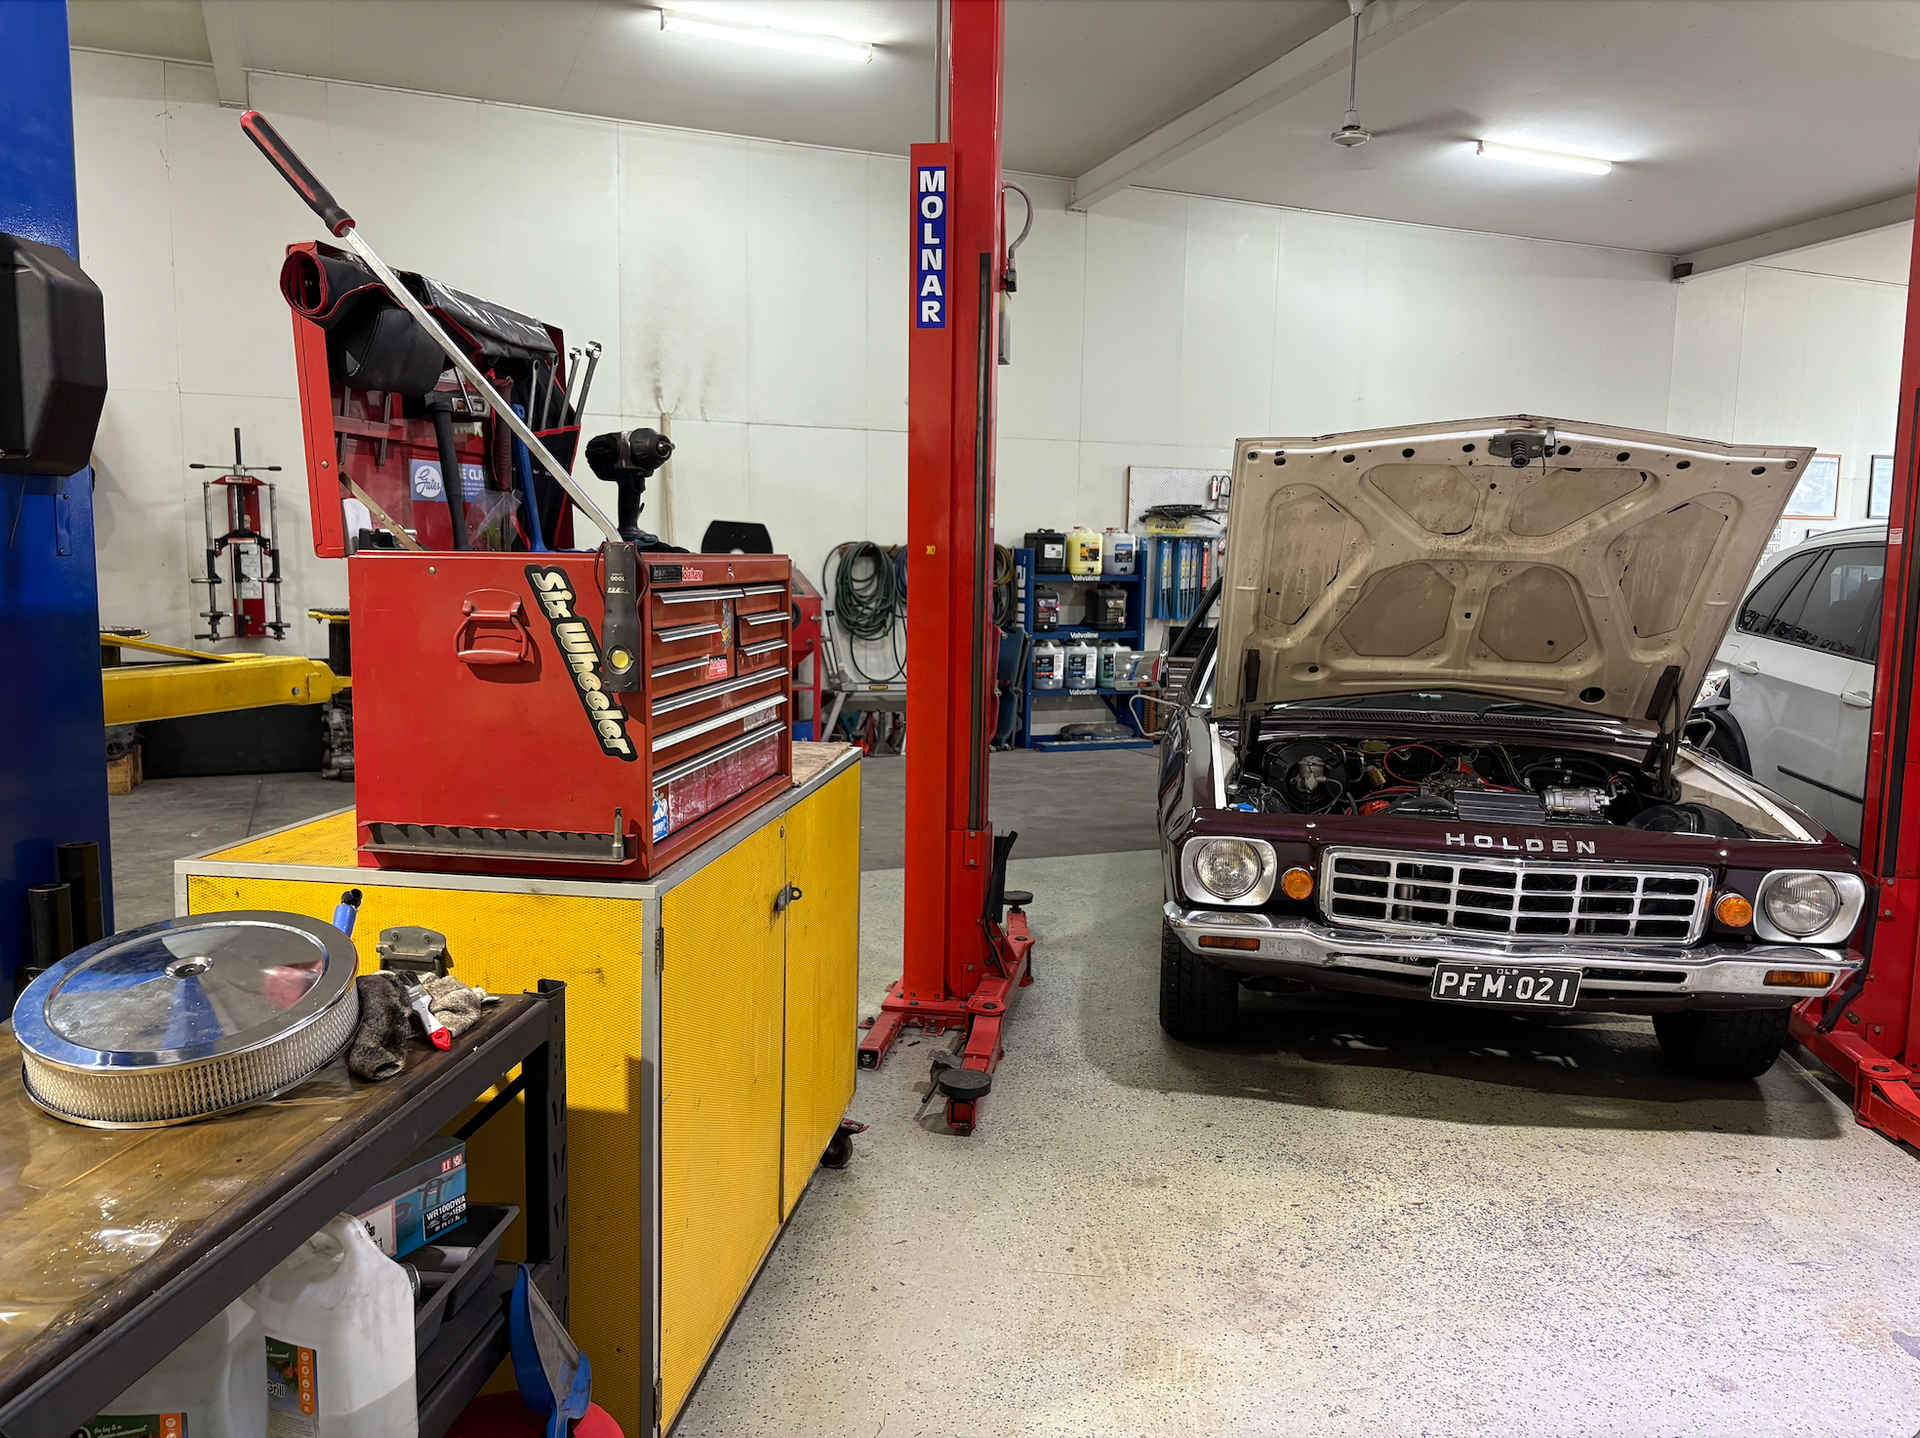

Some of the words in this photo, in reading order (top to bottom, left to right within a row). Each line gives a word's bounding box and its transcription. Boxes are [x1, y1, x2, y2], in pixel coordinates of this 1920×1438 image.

[919, 170, 946, 323] MOLNAR
[469, 468, 485, 481] CLA
[1072, 574, 1101, 582] Valvoline
[531, 571, 573, 620] Six
[555, 622, 631, 755] Wheeler
[1445, 832, 1597, 855] HOLDEN
